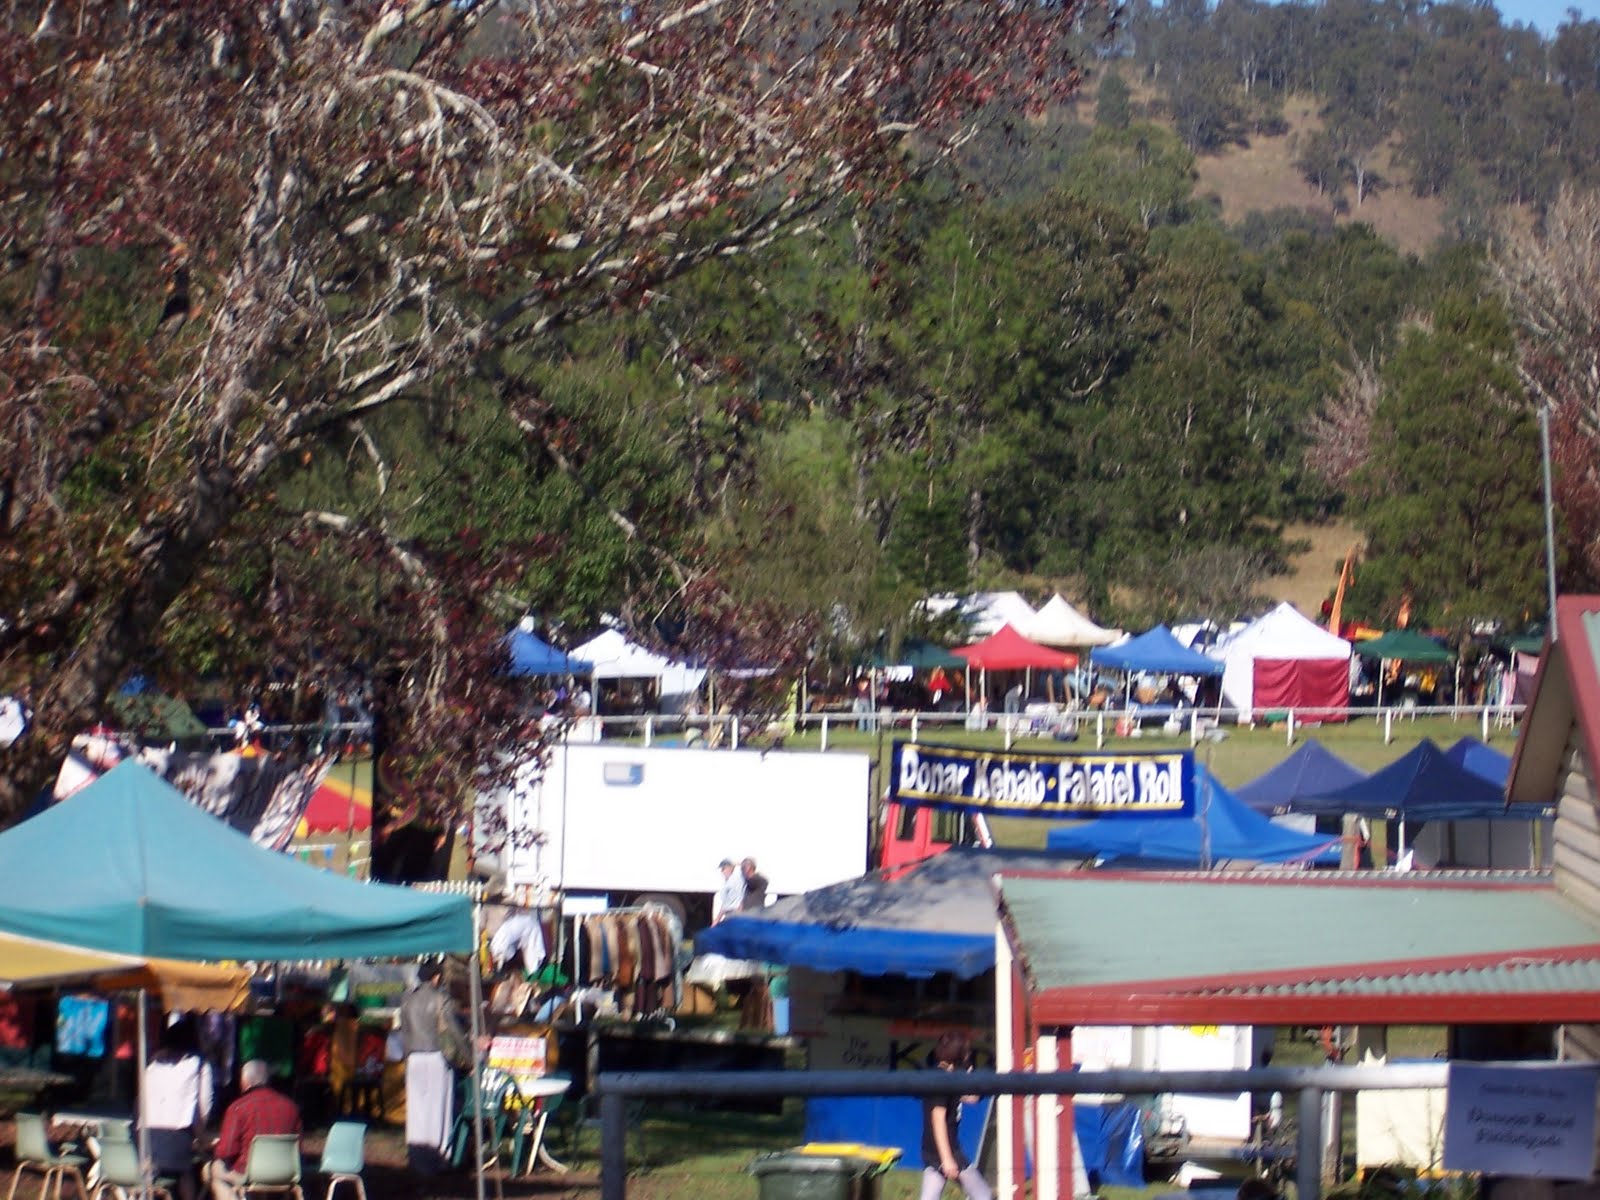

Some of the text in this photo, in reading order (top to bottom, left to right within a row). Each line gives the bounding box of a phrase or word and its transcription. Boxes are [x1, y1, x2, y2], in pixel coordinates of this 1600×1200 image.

[900, 747, 1182, 805] Donar Kebab Falafel Roll
